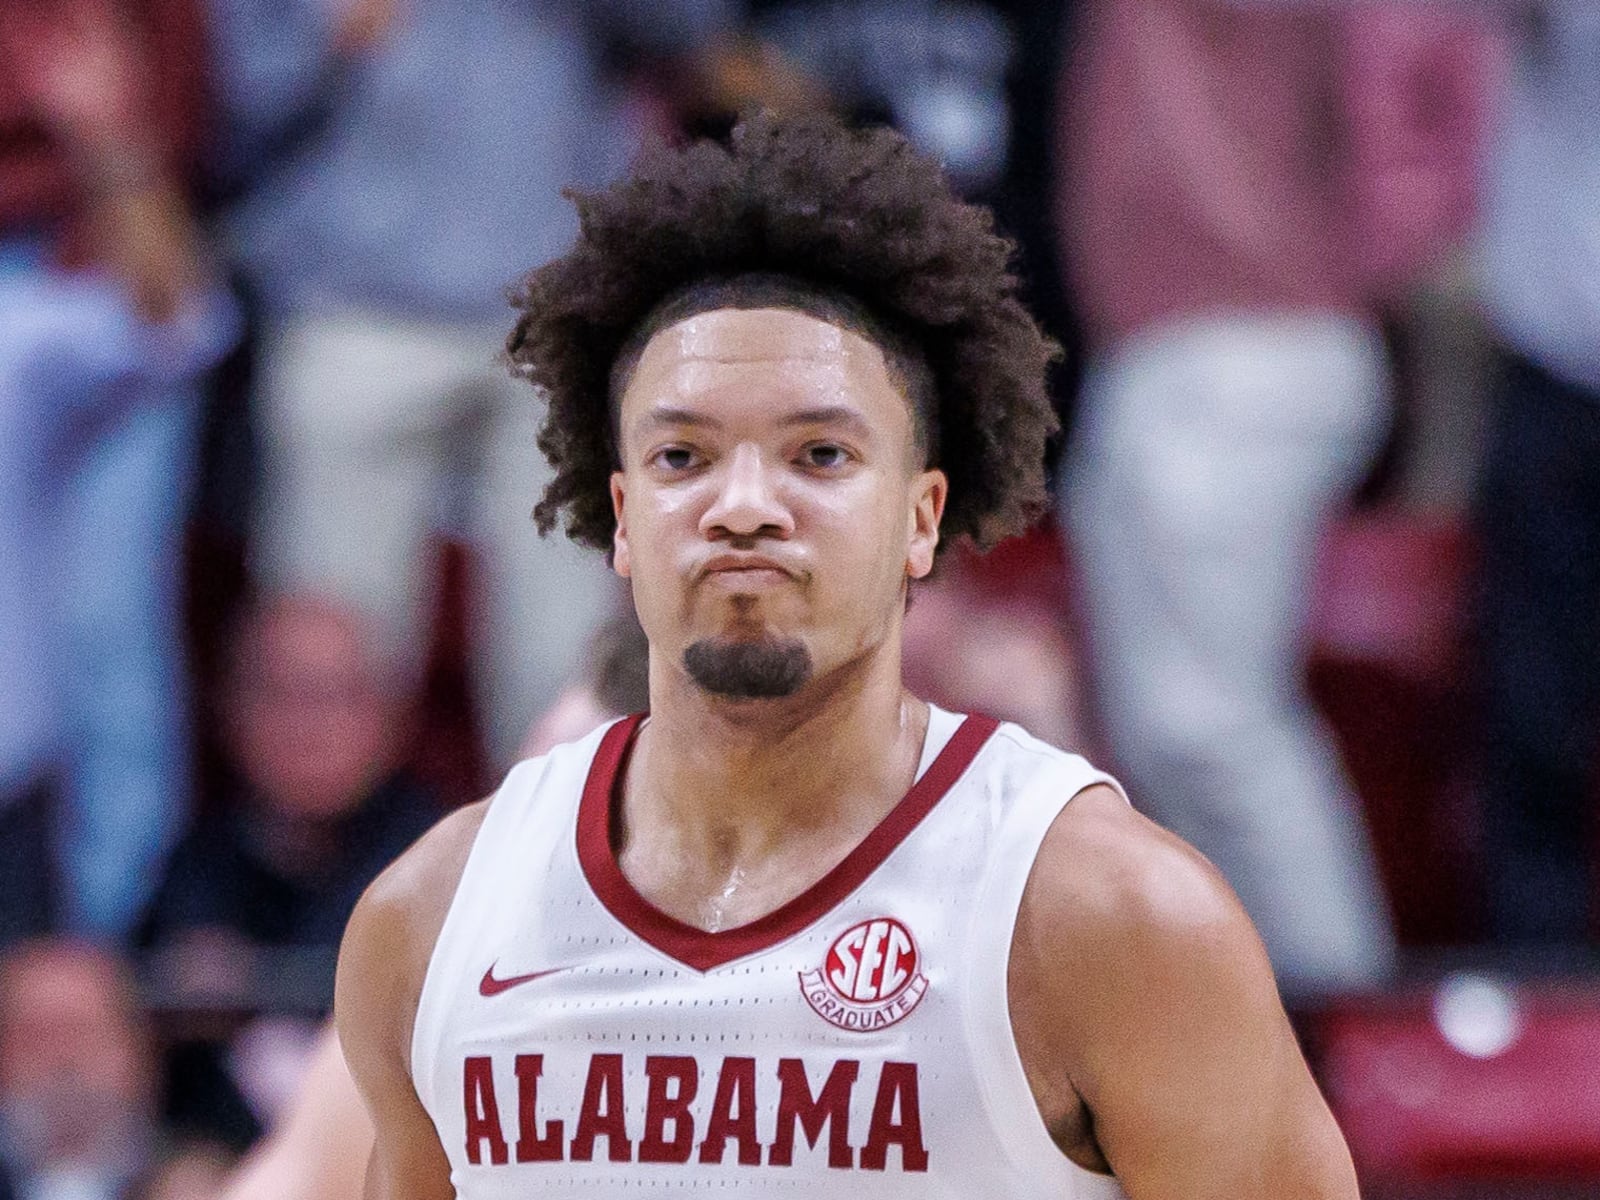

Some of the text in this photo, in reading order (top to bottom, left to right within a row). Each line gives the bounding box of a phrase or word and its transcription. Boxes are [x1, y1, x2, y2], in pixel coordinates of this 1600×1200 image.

[830, 921, 912, 1001] SEC
[809, 990, 909, 1029] GRADUATE
[463, 1054, 928, 1171] ALABAMA
